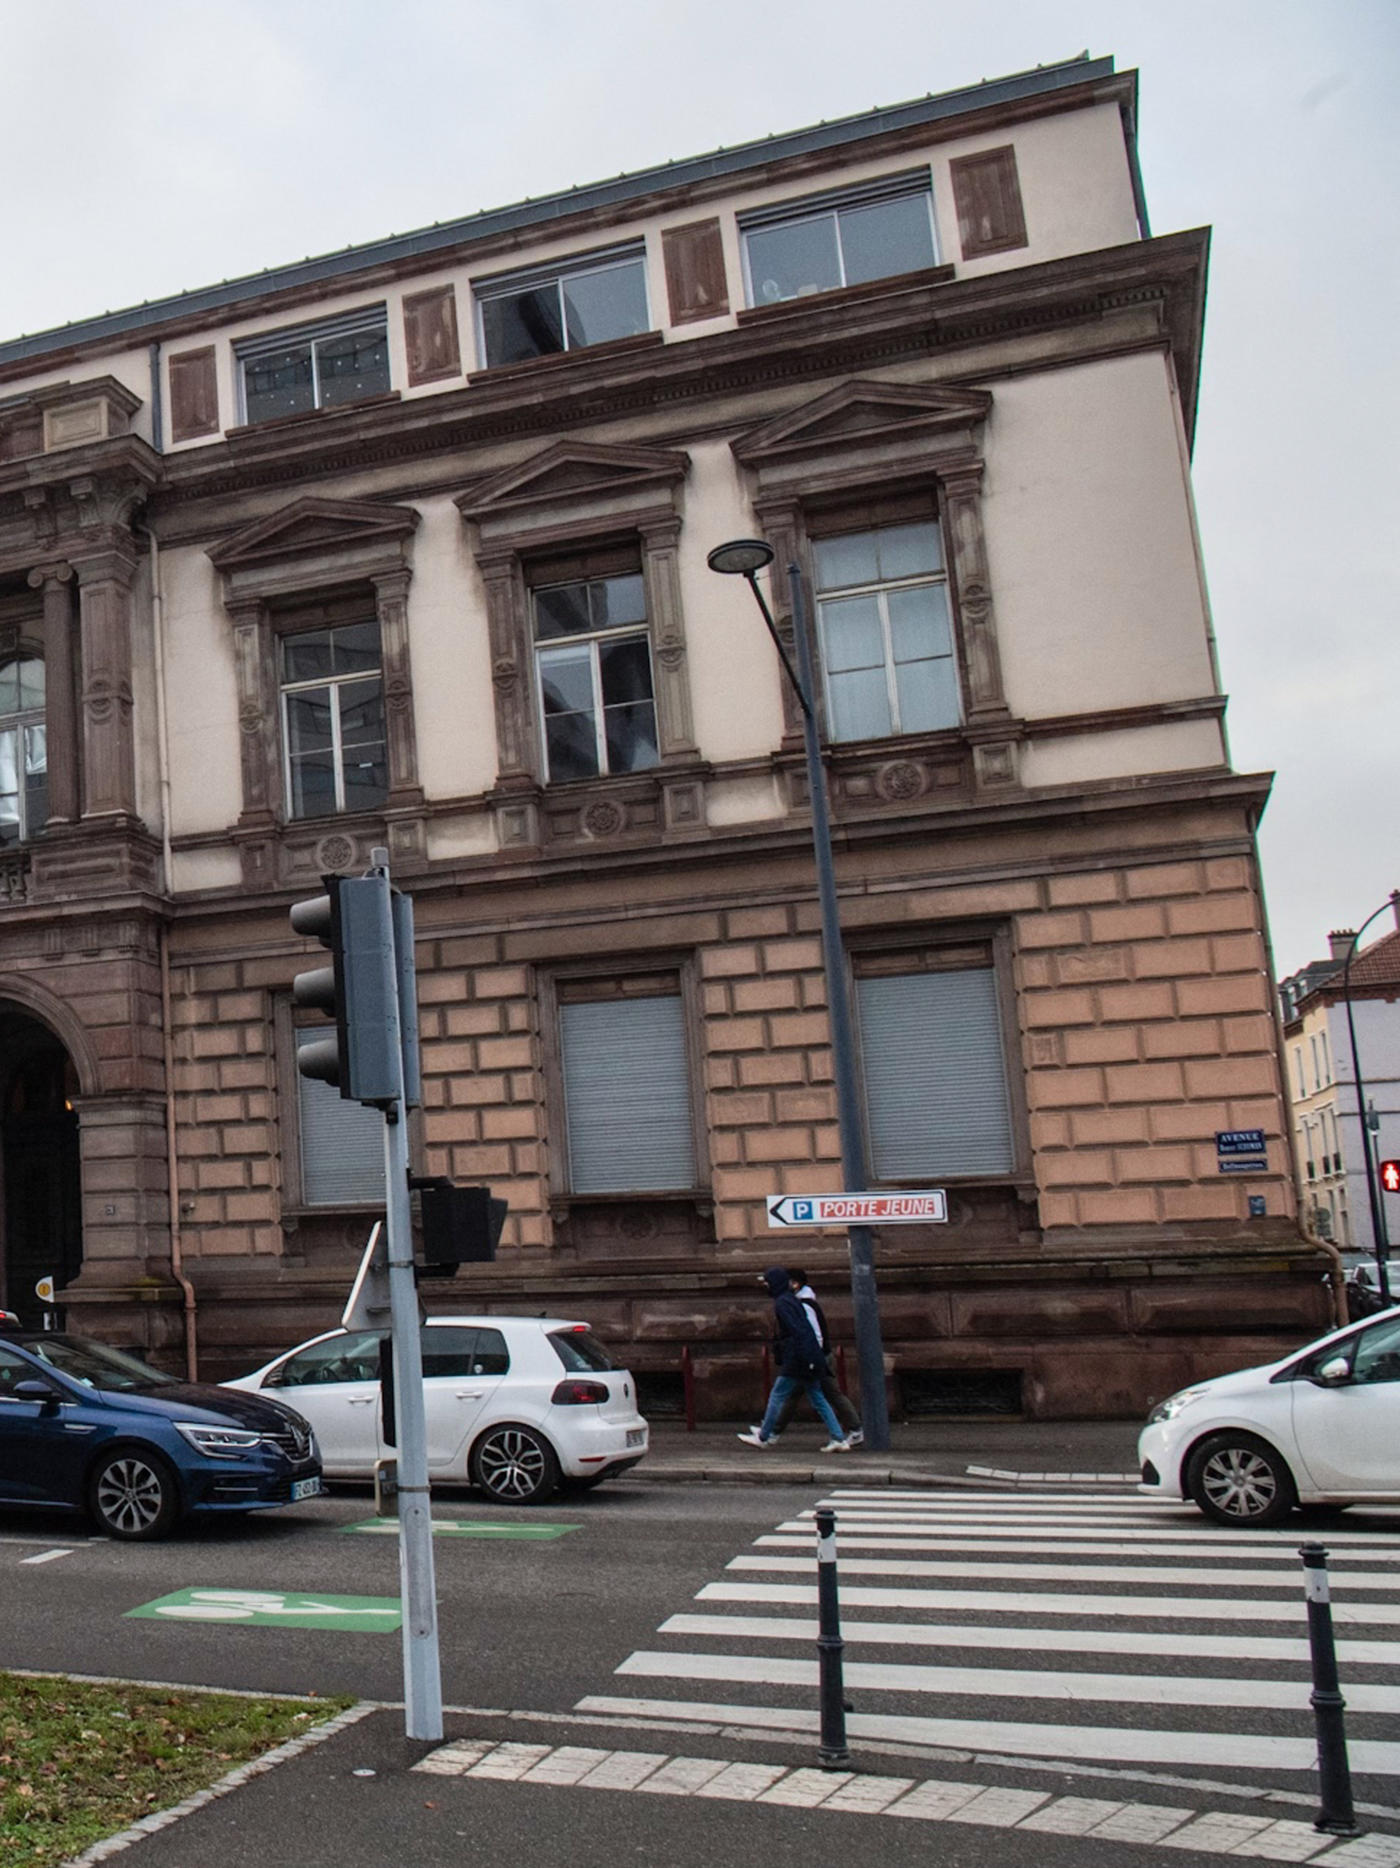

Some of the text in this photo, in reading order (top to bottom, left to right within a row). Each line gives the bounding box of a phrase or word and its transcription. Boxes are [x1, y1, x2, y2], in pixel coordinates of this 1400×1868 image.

[1221, 1132, 1260, 1142] AVENUE
[797, 1198, 934, 1218] P PORTE JEUNE
